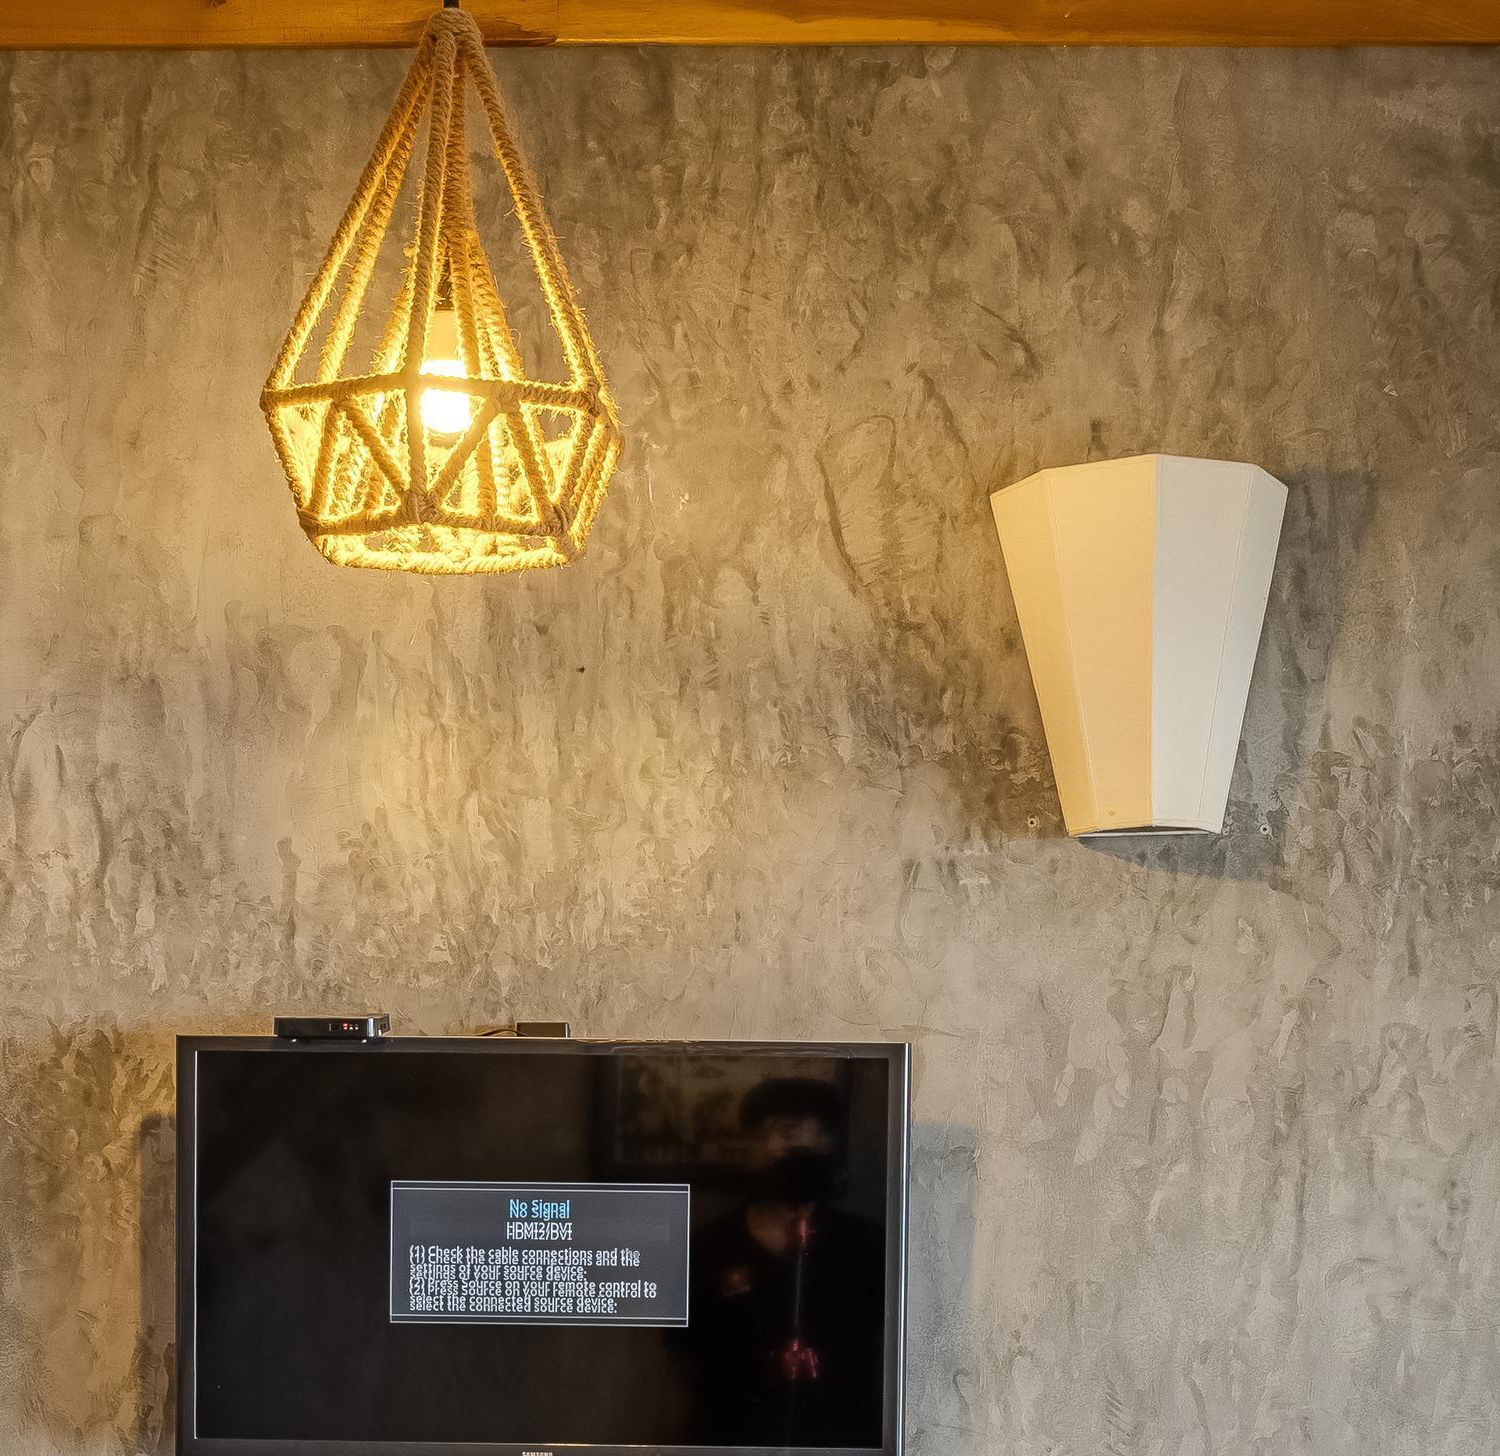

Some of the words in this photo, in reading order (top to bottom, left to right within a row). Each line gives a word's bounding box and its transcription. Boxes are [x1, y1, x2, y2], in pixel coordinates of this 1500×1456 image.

[509, 1199, 528, 1219] No
[531, 1199, 571, 1221] Signal
[506, 1222, 573, 1240] HDMI2/DVI
[428, 1245, 463, 1264] Check
[466, 1246, 485, 1264] the
[488, 1247, 519, 1265] cable
[522, 1248, 593, 1266] connections
[595, 1248, 618, 1266] and
[620, 1248, 640, 1266] the
[410, 1263, 456, 1281] settings
[459, 1262, 471, 1280] of
[473, 1265, 501, 1281] your
[503, 1265, 543, 1281] source
[428, 1278, 459, 1296] Press
[505, 1280, 520, 1297] on
[523, 1281, 551, 1299] your
[553, 1281, 596, 1298] remote
[599, 1280, 641, 1298] control
[644, 1281, 658, 1298] to
[410, 1293, 444, 1311] select
[447, 1294, 466, 1312] the
[469, 1294, 531, 1312] connected
[534, 1297, 573, 1313] source
